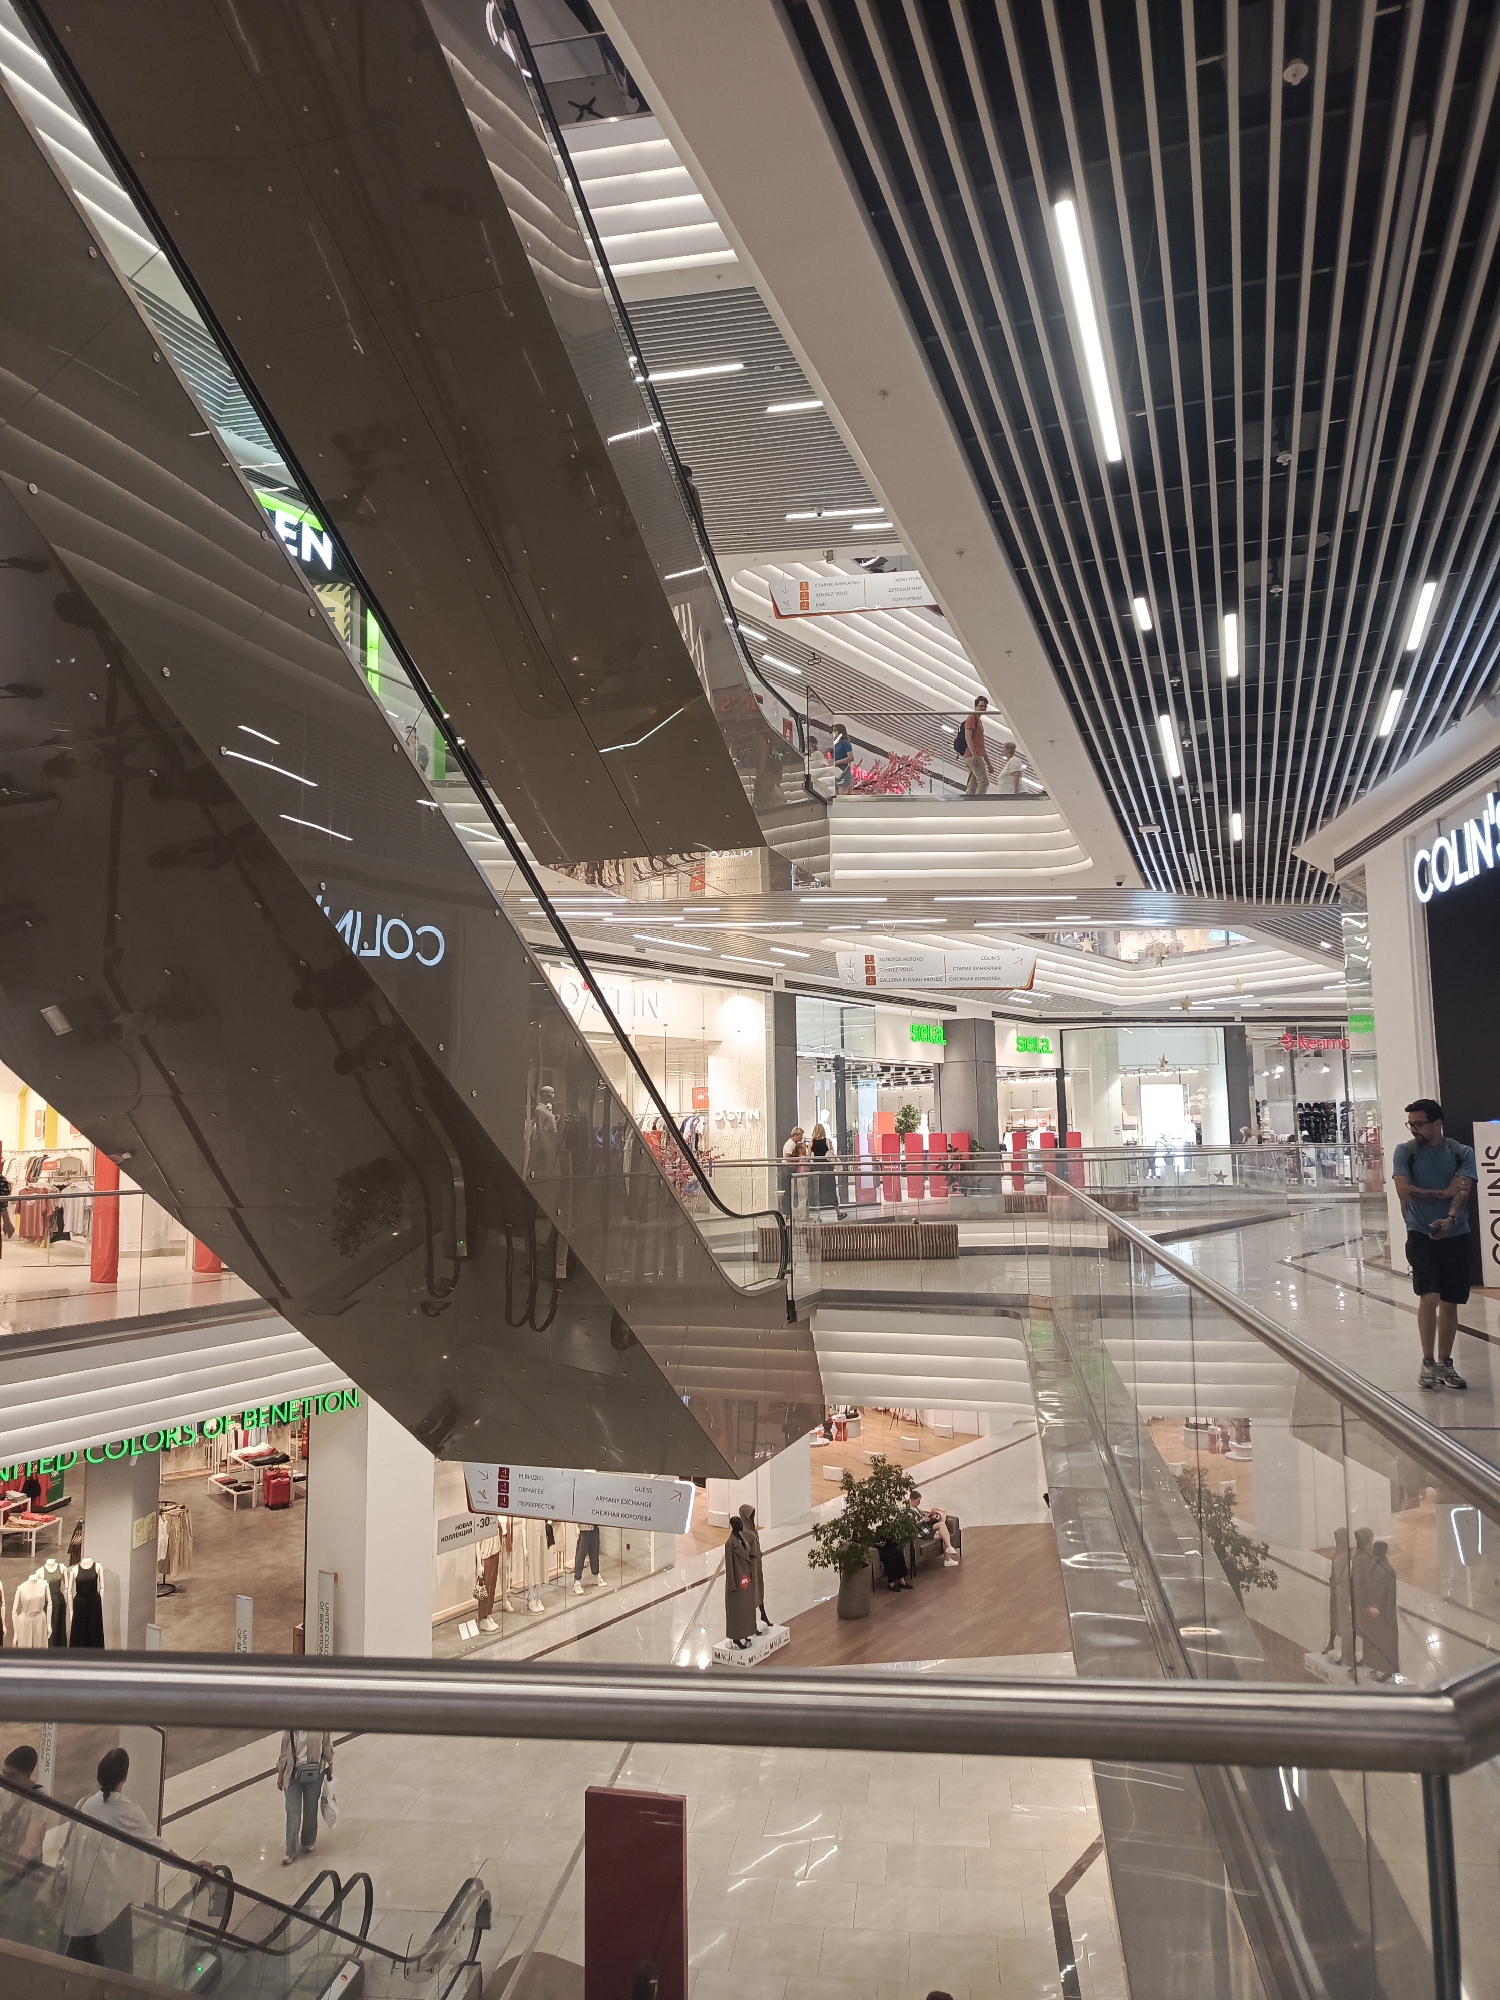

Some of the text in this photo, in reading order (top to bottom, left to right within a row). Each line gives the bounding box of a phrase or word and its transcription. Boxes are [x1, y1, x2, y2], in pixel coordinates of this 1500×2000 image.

[264, 508, 333, 571] EN
[815, 590, 849, 598] RENDEZ-VOUS
[1413, 791, 1500, 903] COLIN'
[84, 1423, 196, 1465] COLORS
[203, 1415, 239, 1439] OF
[634, 1485, 653, 1494] GUESS
[517, 1500, 556, 1511] ПЕРЕКРЕСТОК
[595, 1495, 652, 1509] ARMANY EXCHANGE
[591, 1509, 653, 1523] СНЕЖНАЯ КОРОЛЕВА
[455, 1520, 473, 1531] НОВАЯ
